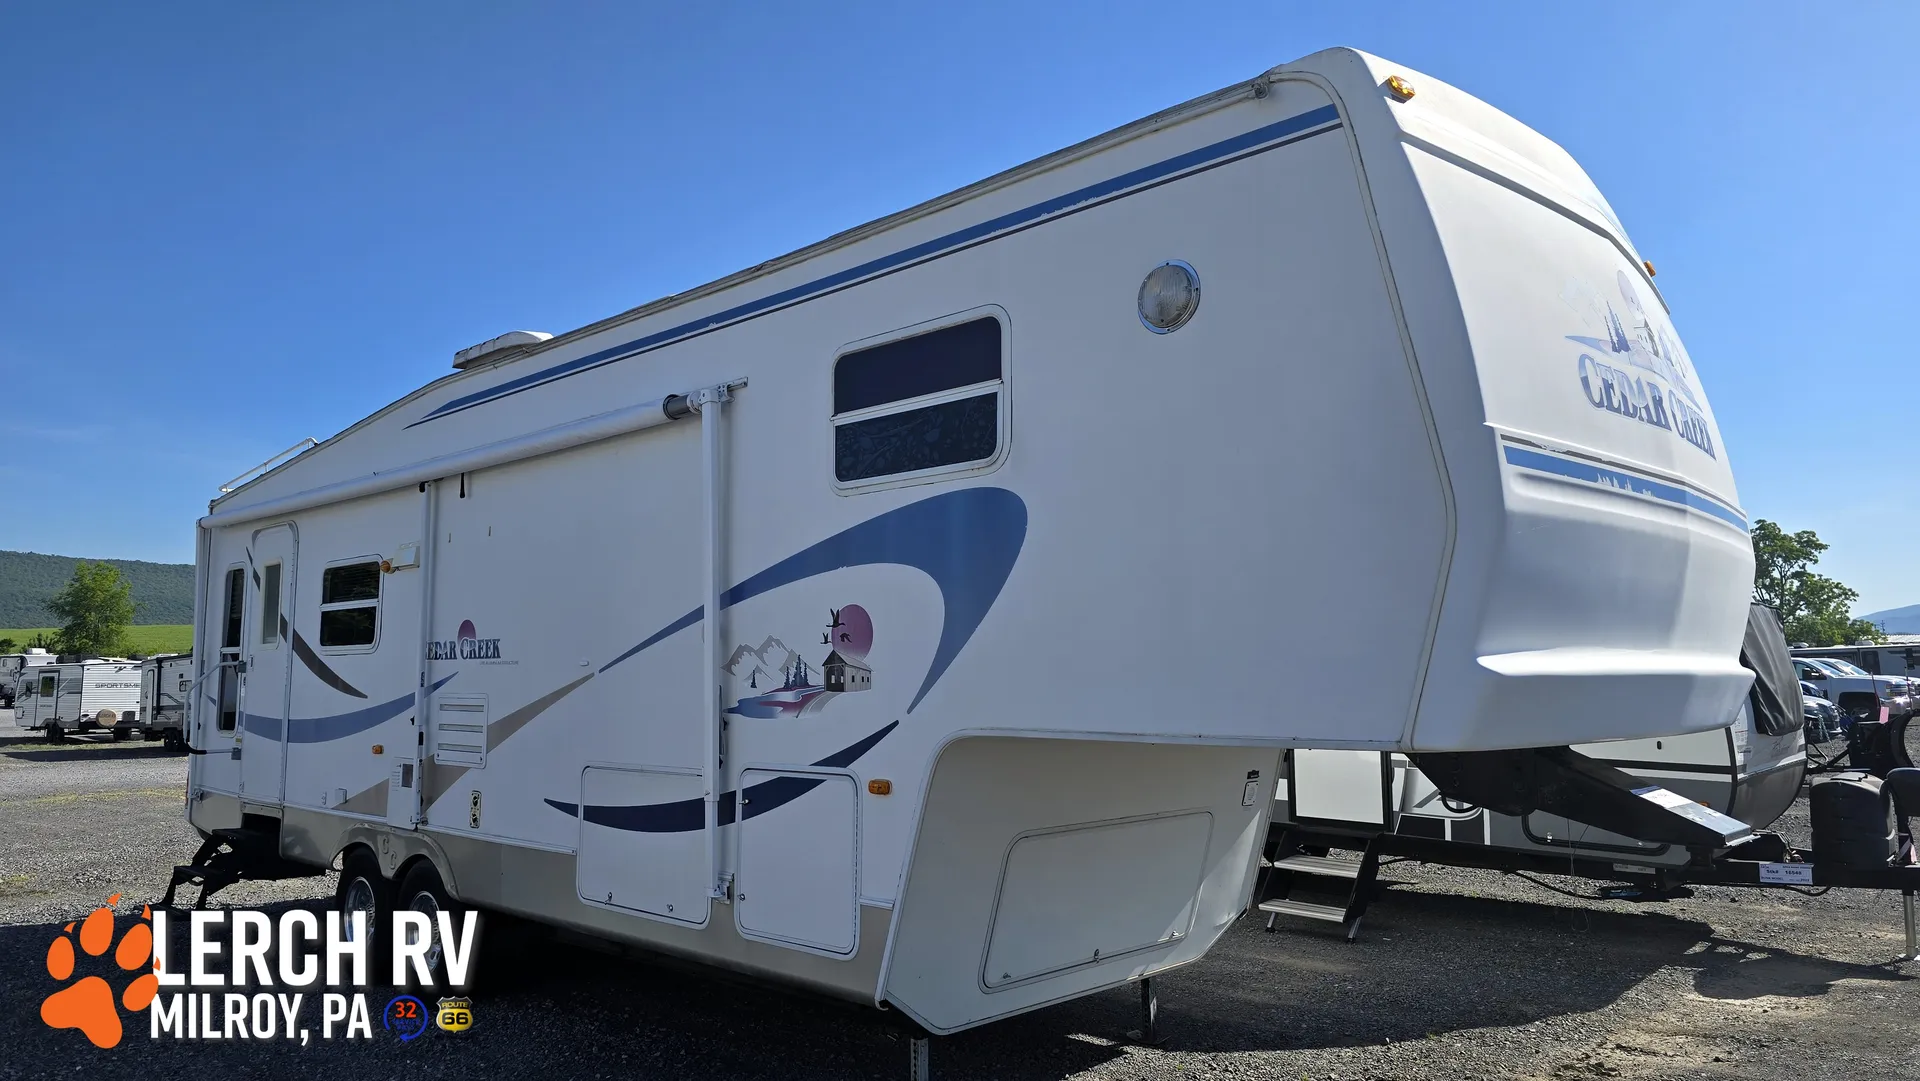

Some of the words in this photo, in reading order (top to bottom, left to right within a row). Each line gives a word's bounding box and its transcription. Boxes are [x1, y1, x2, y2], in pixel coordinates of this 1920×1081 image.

[1578, 353, 1672, 431] CEDAR
[1668, 389, 1716, 461] CREEK
[426, 640, 457, 660] EDAR
[460, 637, 501, 660] CREEK
